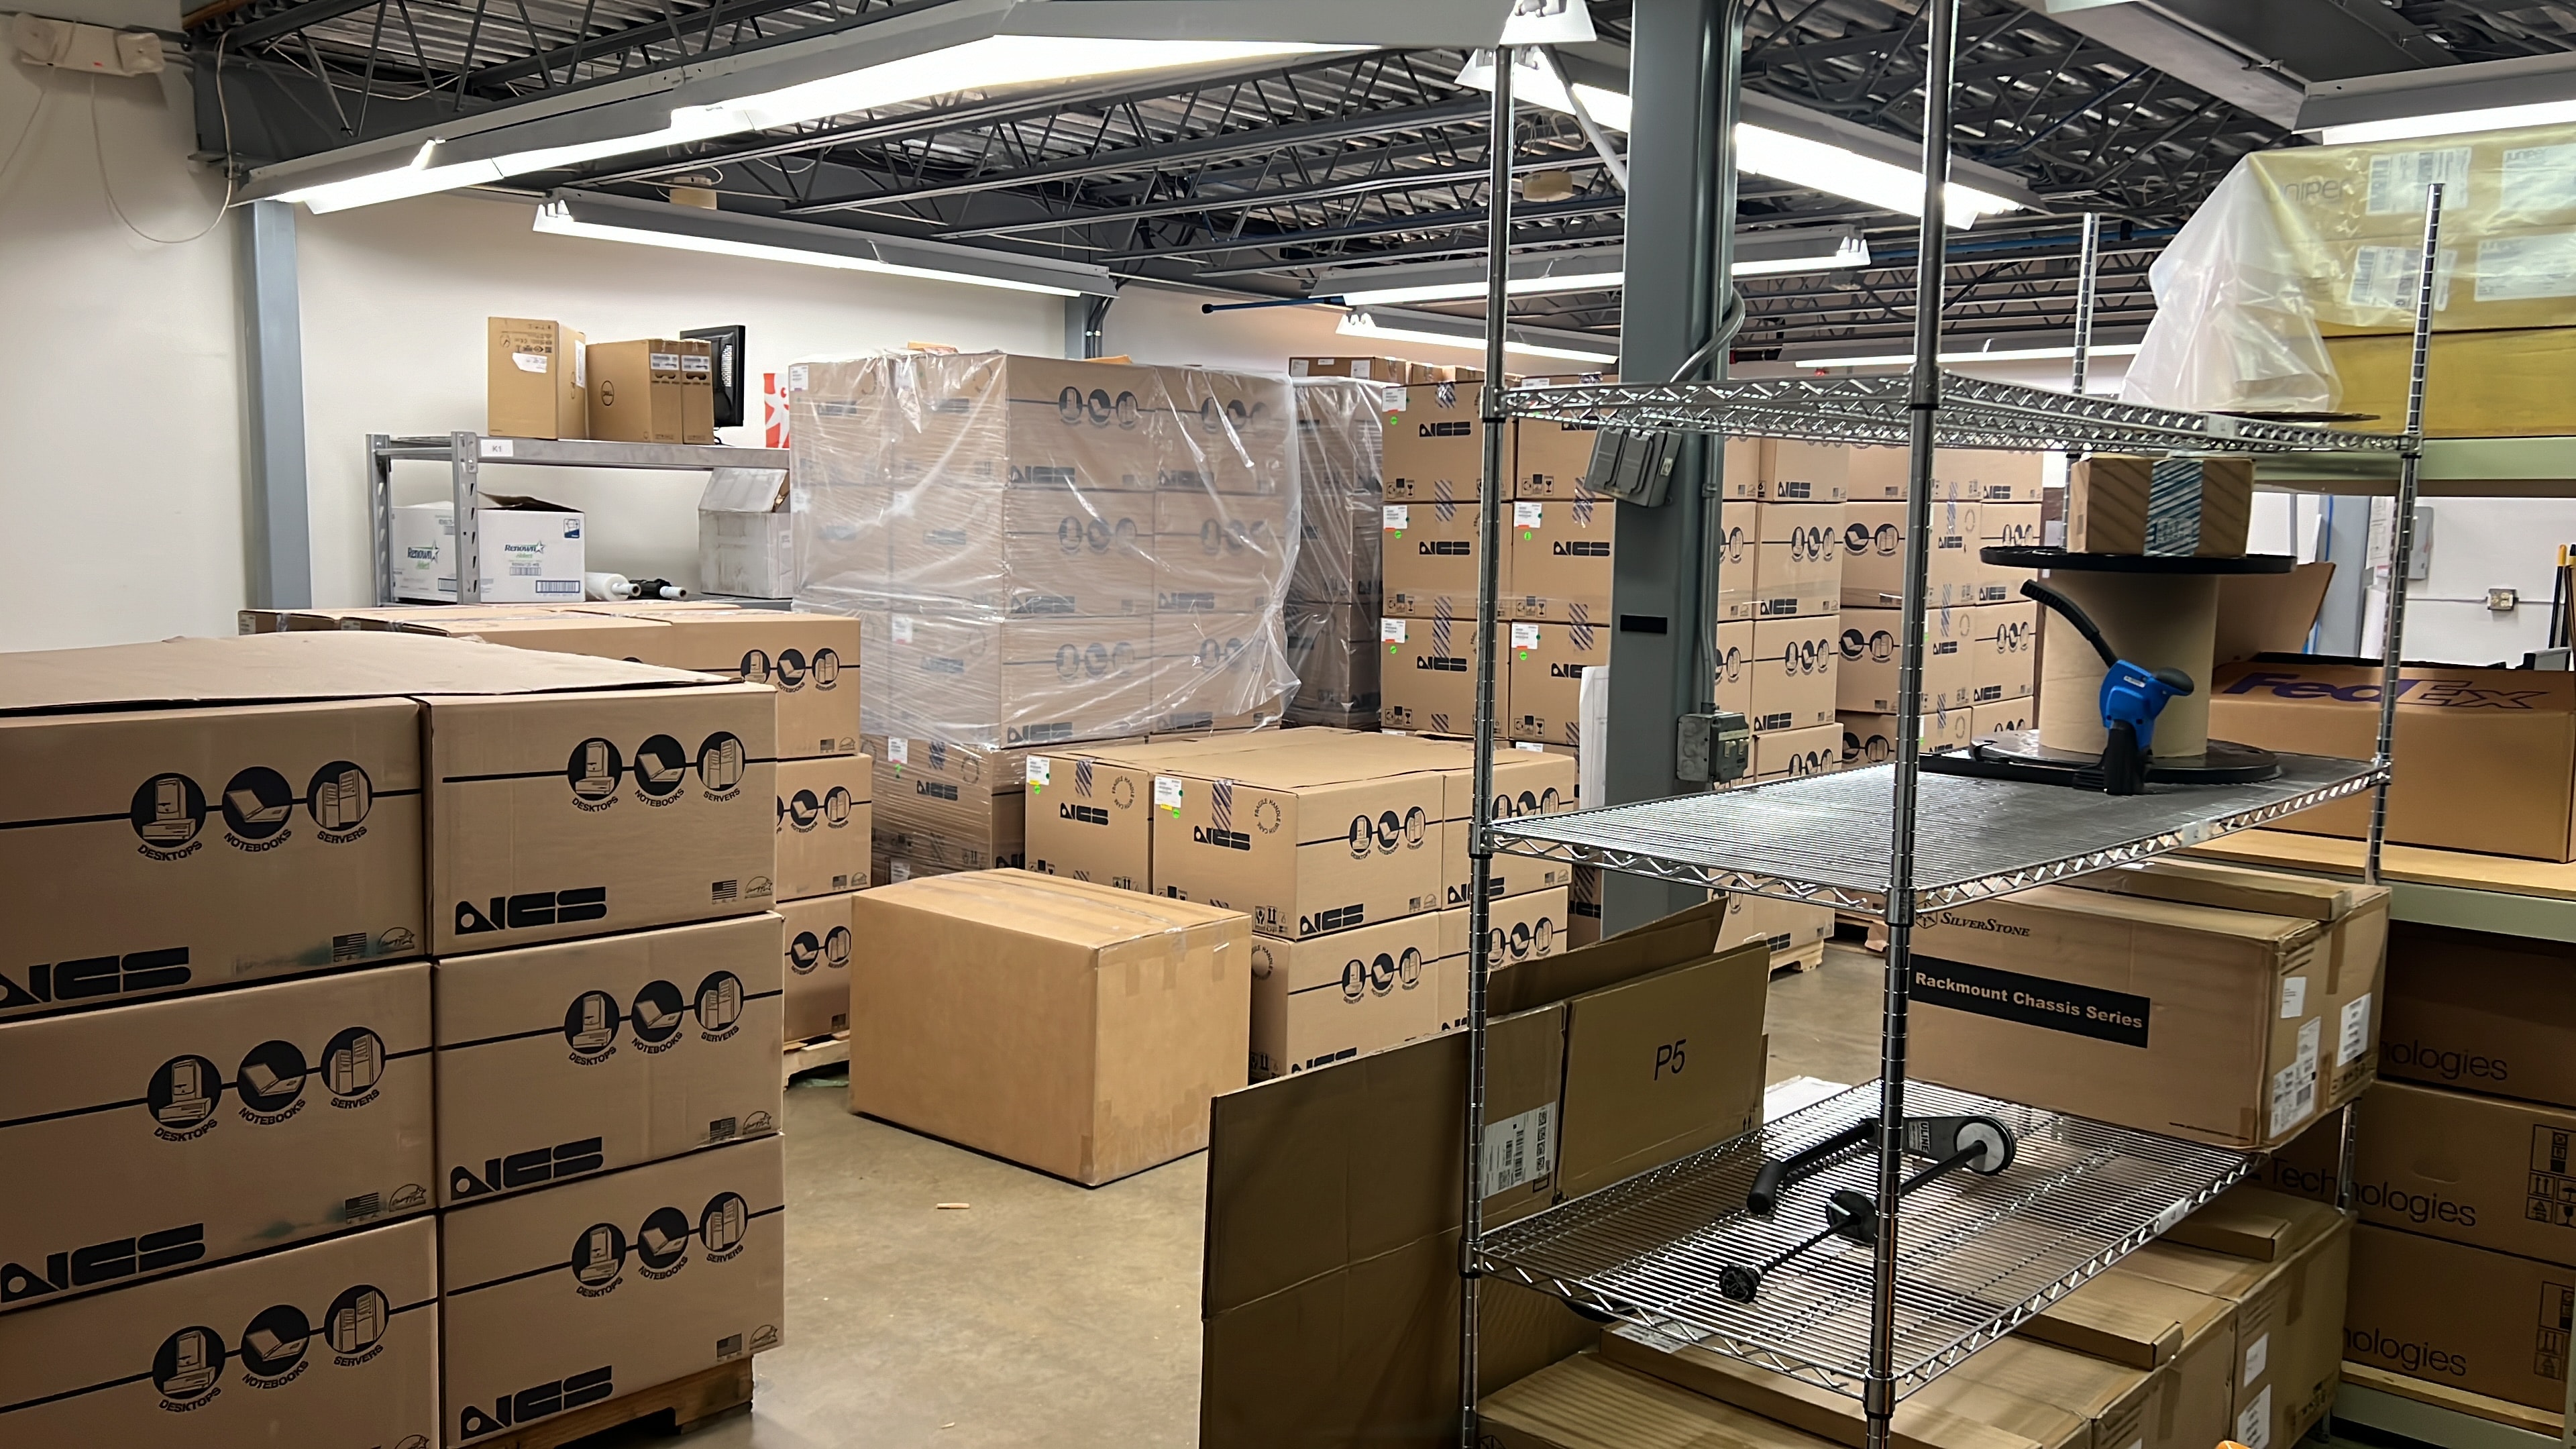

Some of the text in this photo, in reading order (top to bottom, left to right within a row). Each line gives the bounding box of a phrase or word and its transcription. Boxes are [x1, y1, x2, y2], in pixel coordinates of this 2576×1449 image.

[408, 547, 432, 559] Renown
[2221, 672, 2550, 709] FedEx
[572, 788, 740, 812] DESKTOPS NOTEBOOKS SERVERS
[138, 826, 368, 861] DESKTOPS NOTEBOOKS SERVERS
[1915, 971, 2143, 1029] Rackmount Chassis Series
[569, 1024, 739, 1066] DESKTOPS NOTEBOOKS SERVERS
[1654, 1038, 1686, 1081] P5
[154, 1089, 380, 1142] DESKTOPS NOTEBOOKS SERVERS
[1921, 1122, 1929, 1152] ULINE
[576, 1244, 744, 1298] DESKTOPS NOTEBOOKS SERVERS
[159, 1344, 384, 1413] DESKTOPS NOTEBOOKS SERVERS
